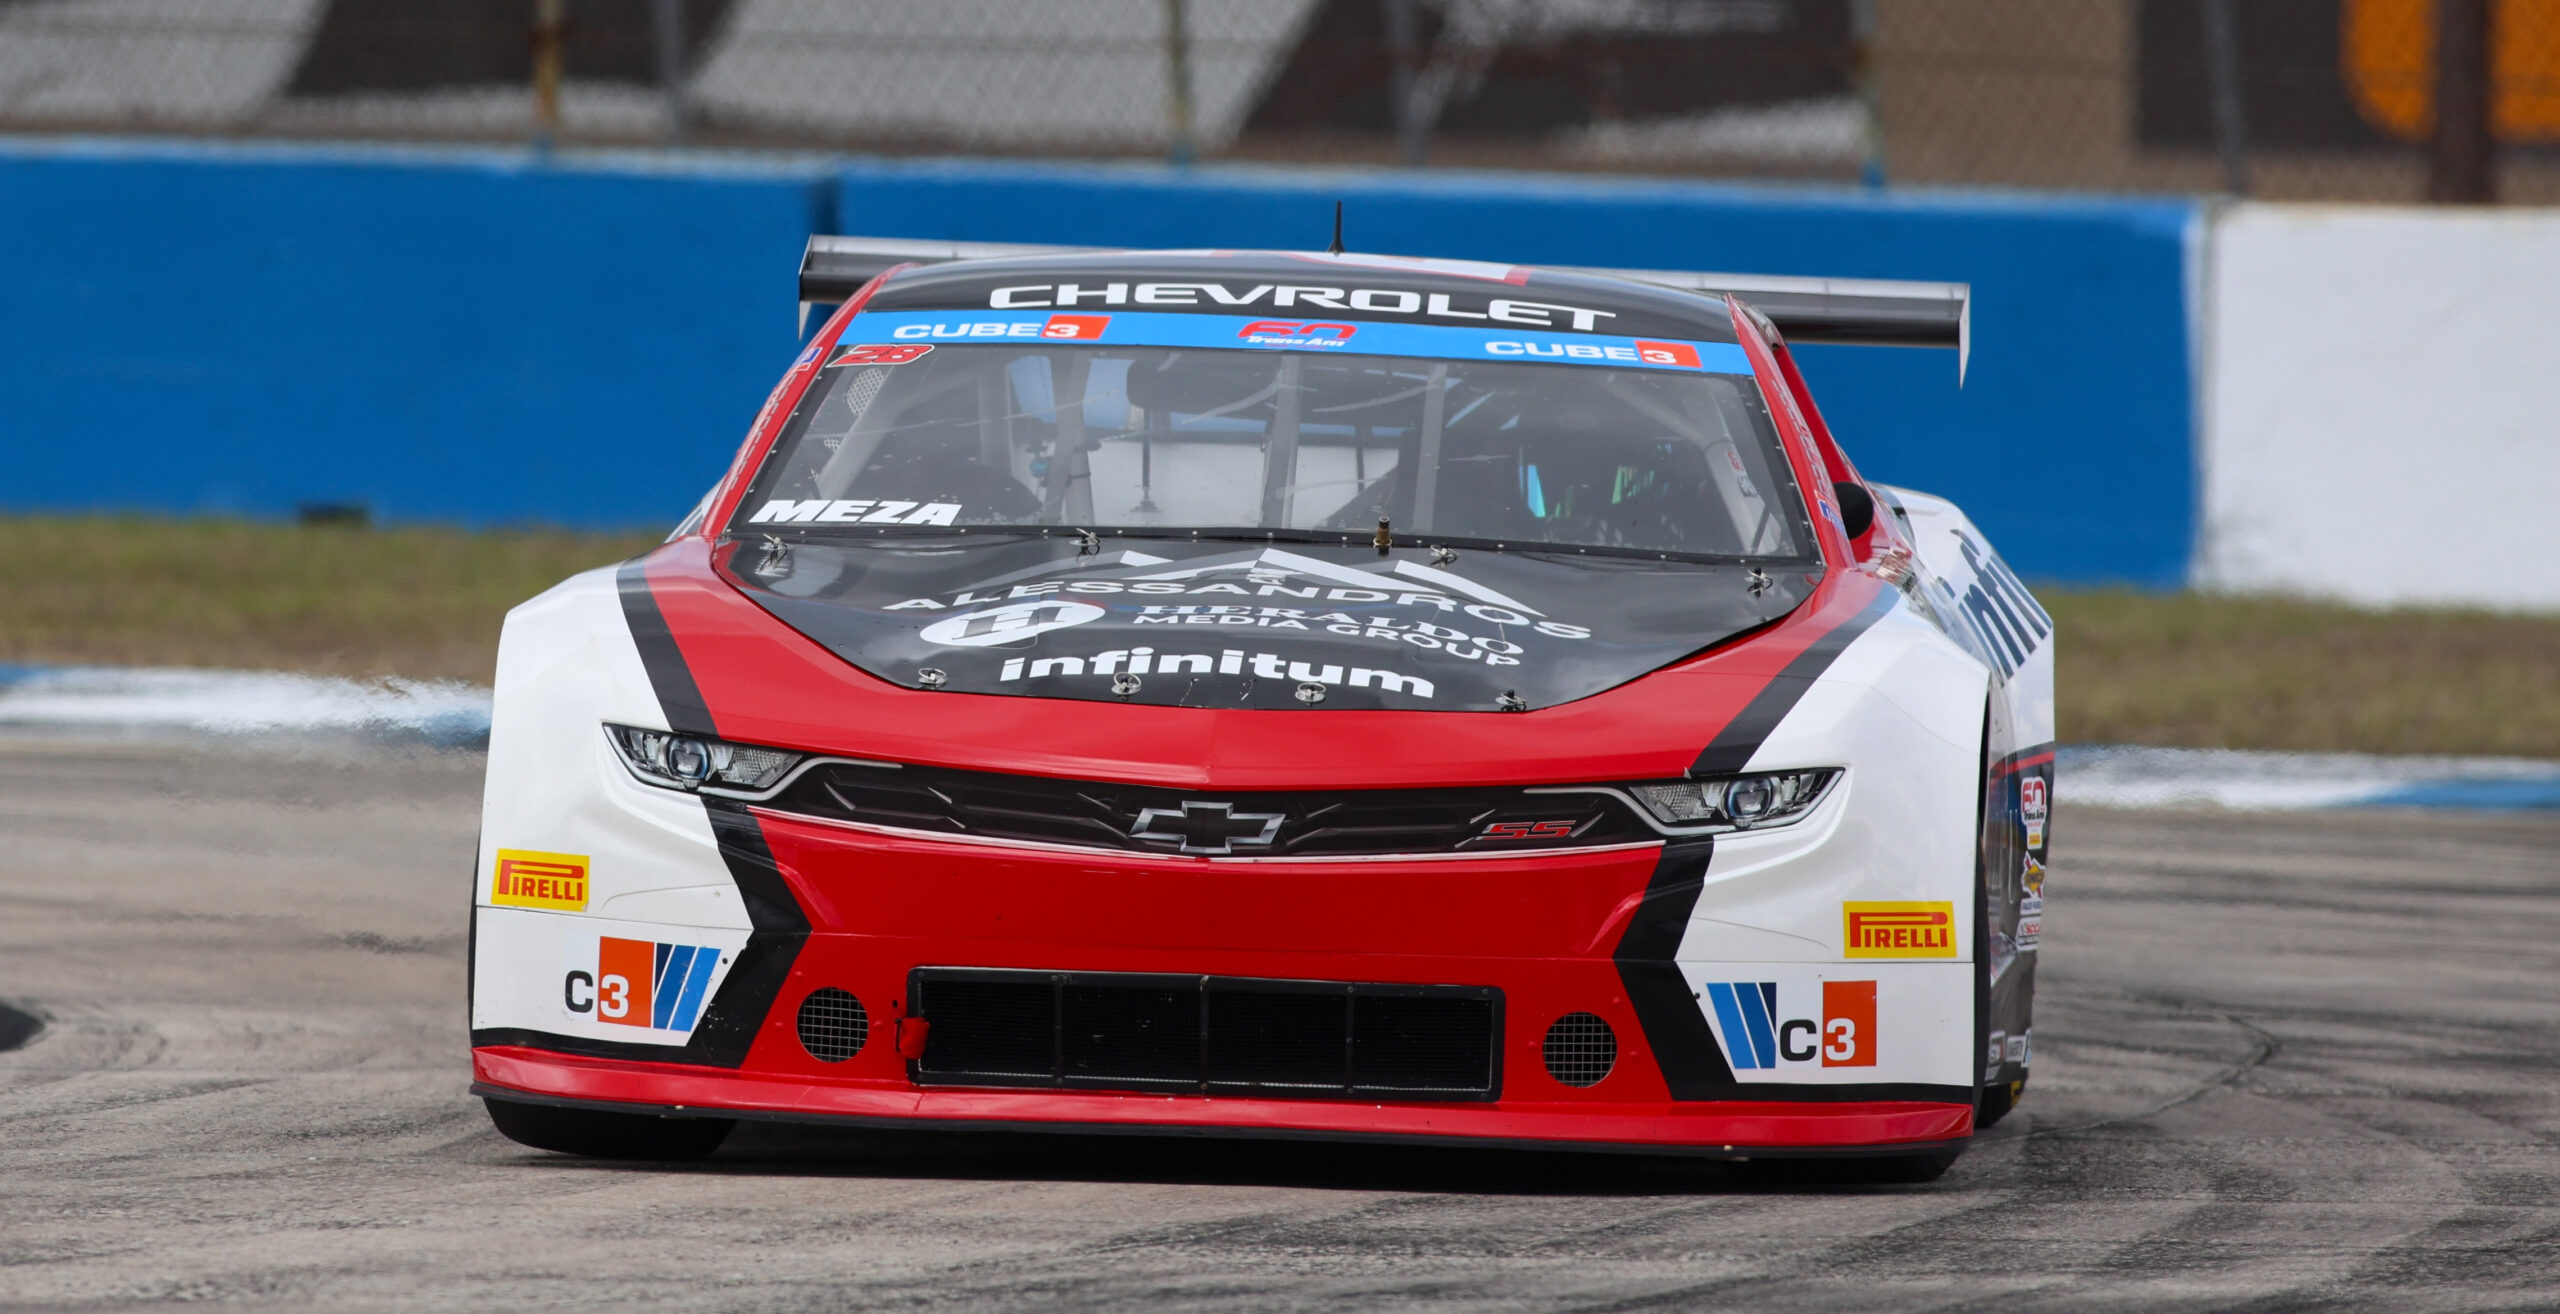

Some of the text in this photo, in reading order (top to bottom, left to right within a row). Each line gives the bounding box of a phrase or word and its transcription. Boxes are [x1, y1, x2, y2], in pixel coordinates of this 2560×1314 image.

[989, 283, 1617, 331] CHEVROLET
[1237, 320, 1358, 339] 60
[1246, 335, 1306, 345] Trans
[1304, 338, 1346, 347] Am
[829, 345, 933, 367] 28
[748, 499, 963, 527] MEZA
[881, 581, 1592, 640] ALESSANDROS
[1136, 604, 1525, 656] HERALDO
[1132, 613, 1521, 667] MEDIA GROUP
[1000, 646, 1435, 700] infinitum
[1481, 819, 1577, 841] SS
[498, 859, 585, 902] PIRELLI
[1849, 911, 1948, 948] PIRELLI
[564, 969, 630, 1018] C3
[1779, 1017, 1856, 1062] C3
